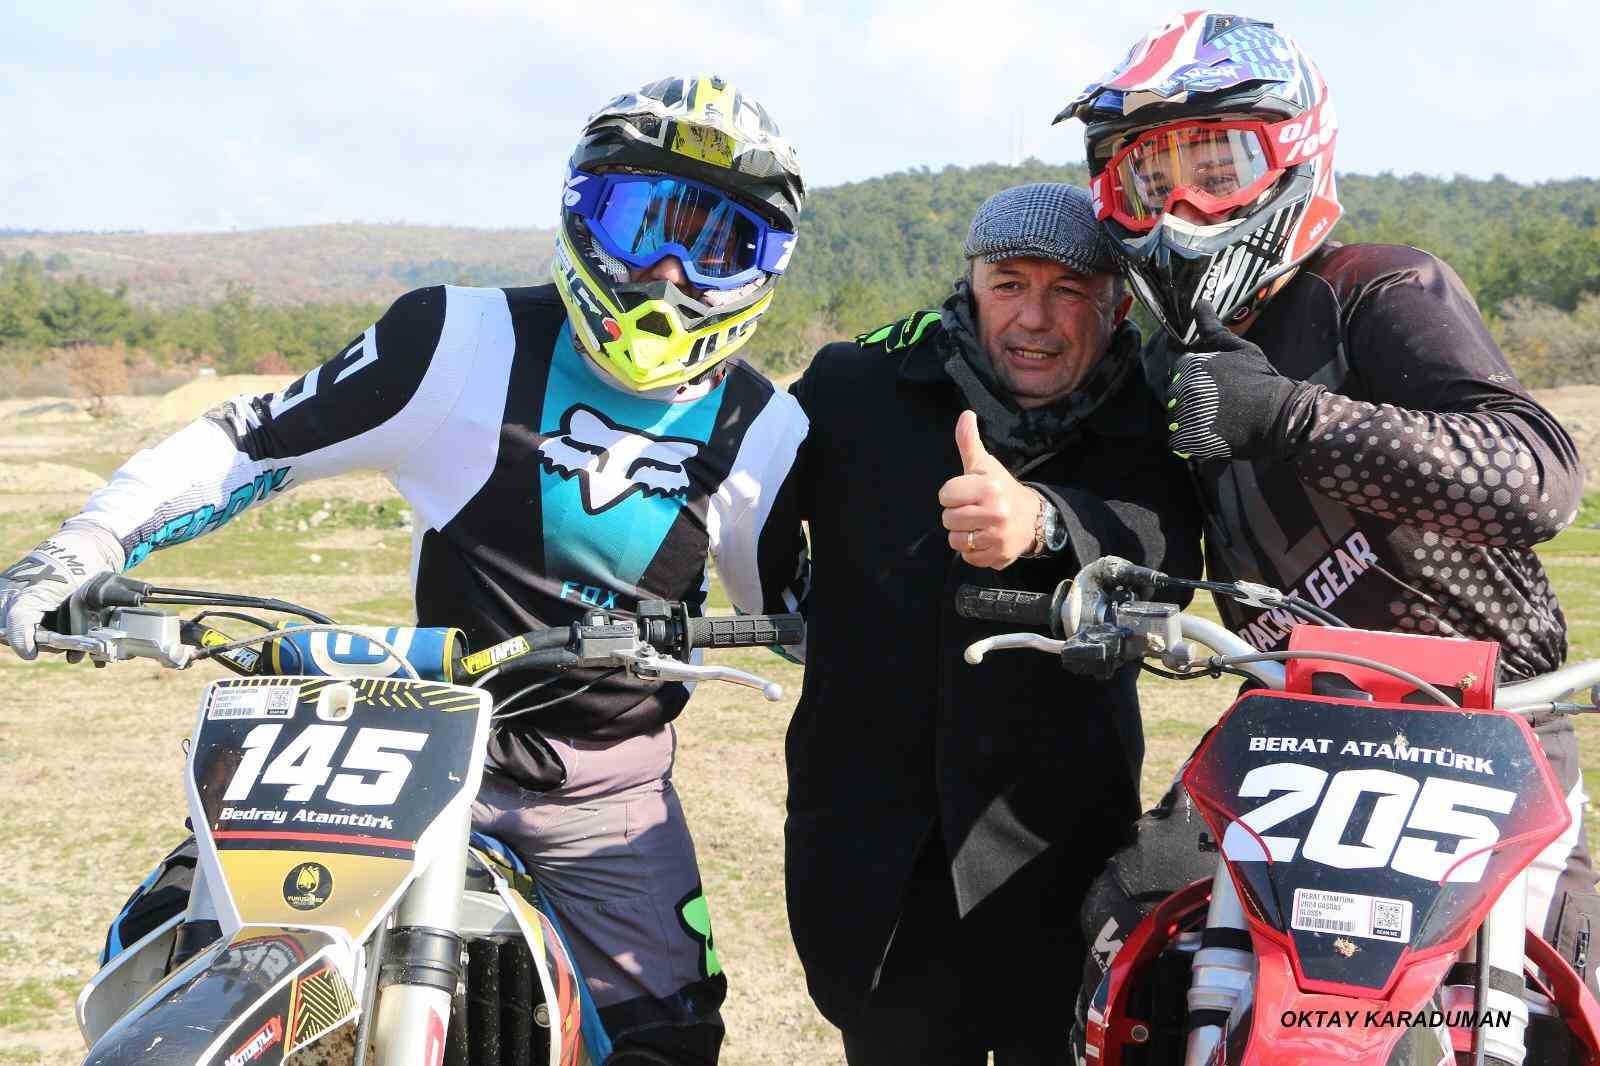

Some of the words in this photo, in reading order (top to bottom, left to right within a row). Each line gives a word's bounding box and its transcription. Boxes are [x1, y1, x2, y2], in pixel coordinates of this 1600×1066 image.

[560, 580, 619, 609] FOX
[1305, 531, 1378, 609] GEAR
[221, 723, 430, 806] 145
[1248, 737, 1334, 755] BERAT
[1340, 740, 1495, 775] ATAMTÜRK
[220, 807, 288, 824] Bedray
[292, 811, 394, 830] Atamtürk
[1222, 762, 1518, 883] 205
